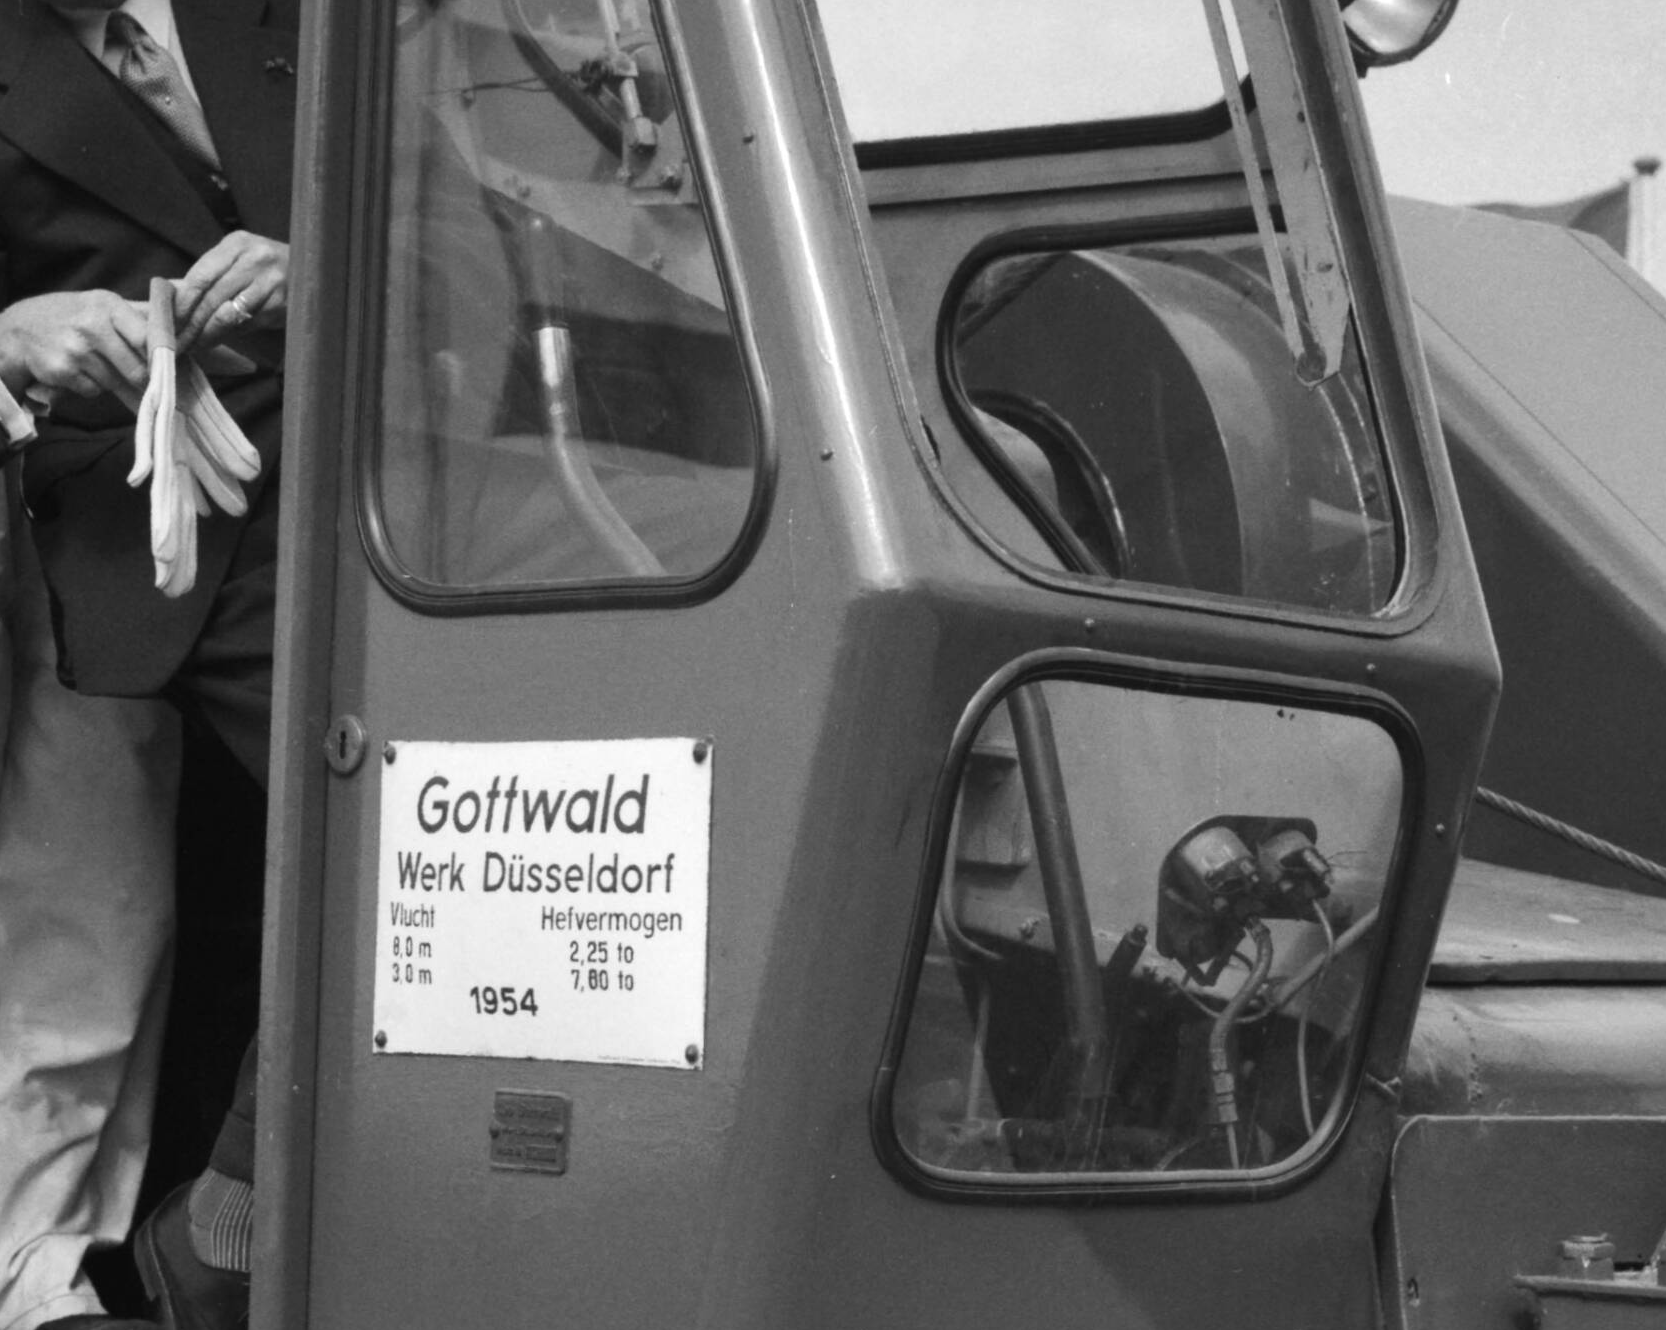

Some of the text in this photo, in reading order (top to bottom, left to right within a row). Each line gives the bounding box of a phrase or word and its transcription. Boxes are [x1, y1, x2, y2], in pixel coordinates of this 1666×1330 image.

[416, 773, 651, 835] Gottwald
[397, 850, 676, 894] Werk Düsseldorf
[390, 901, 436, 929] Vlucht
[541, 905, 683, 939] Hefvermogen
[418, 941, 433, 959] m
[569, 940, 635, 966] 2,25 to
[418, 968, 433, 985] m
[617, 970, 635, 992] to
[469, 985, 539, 1018] 1954
